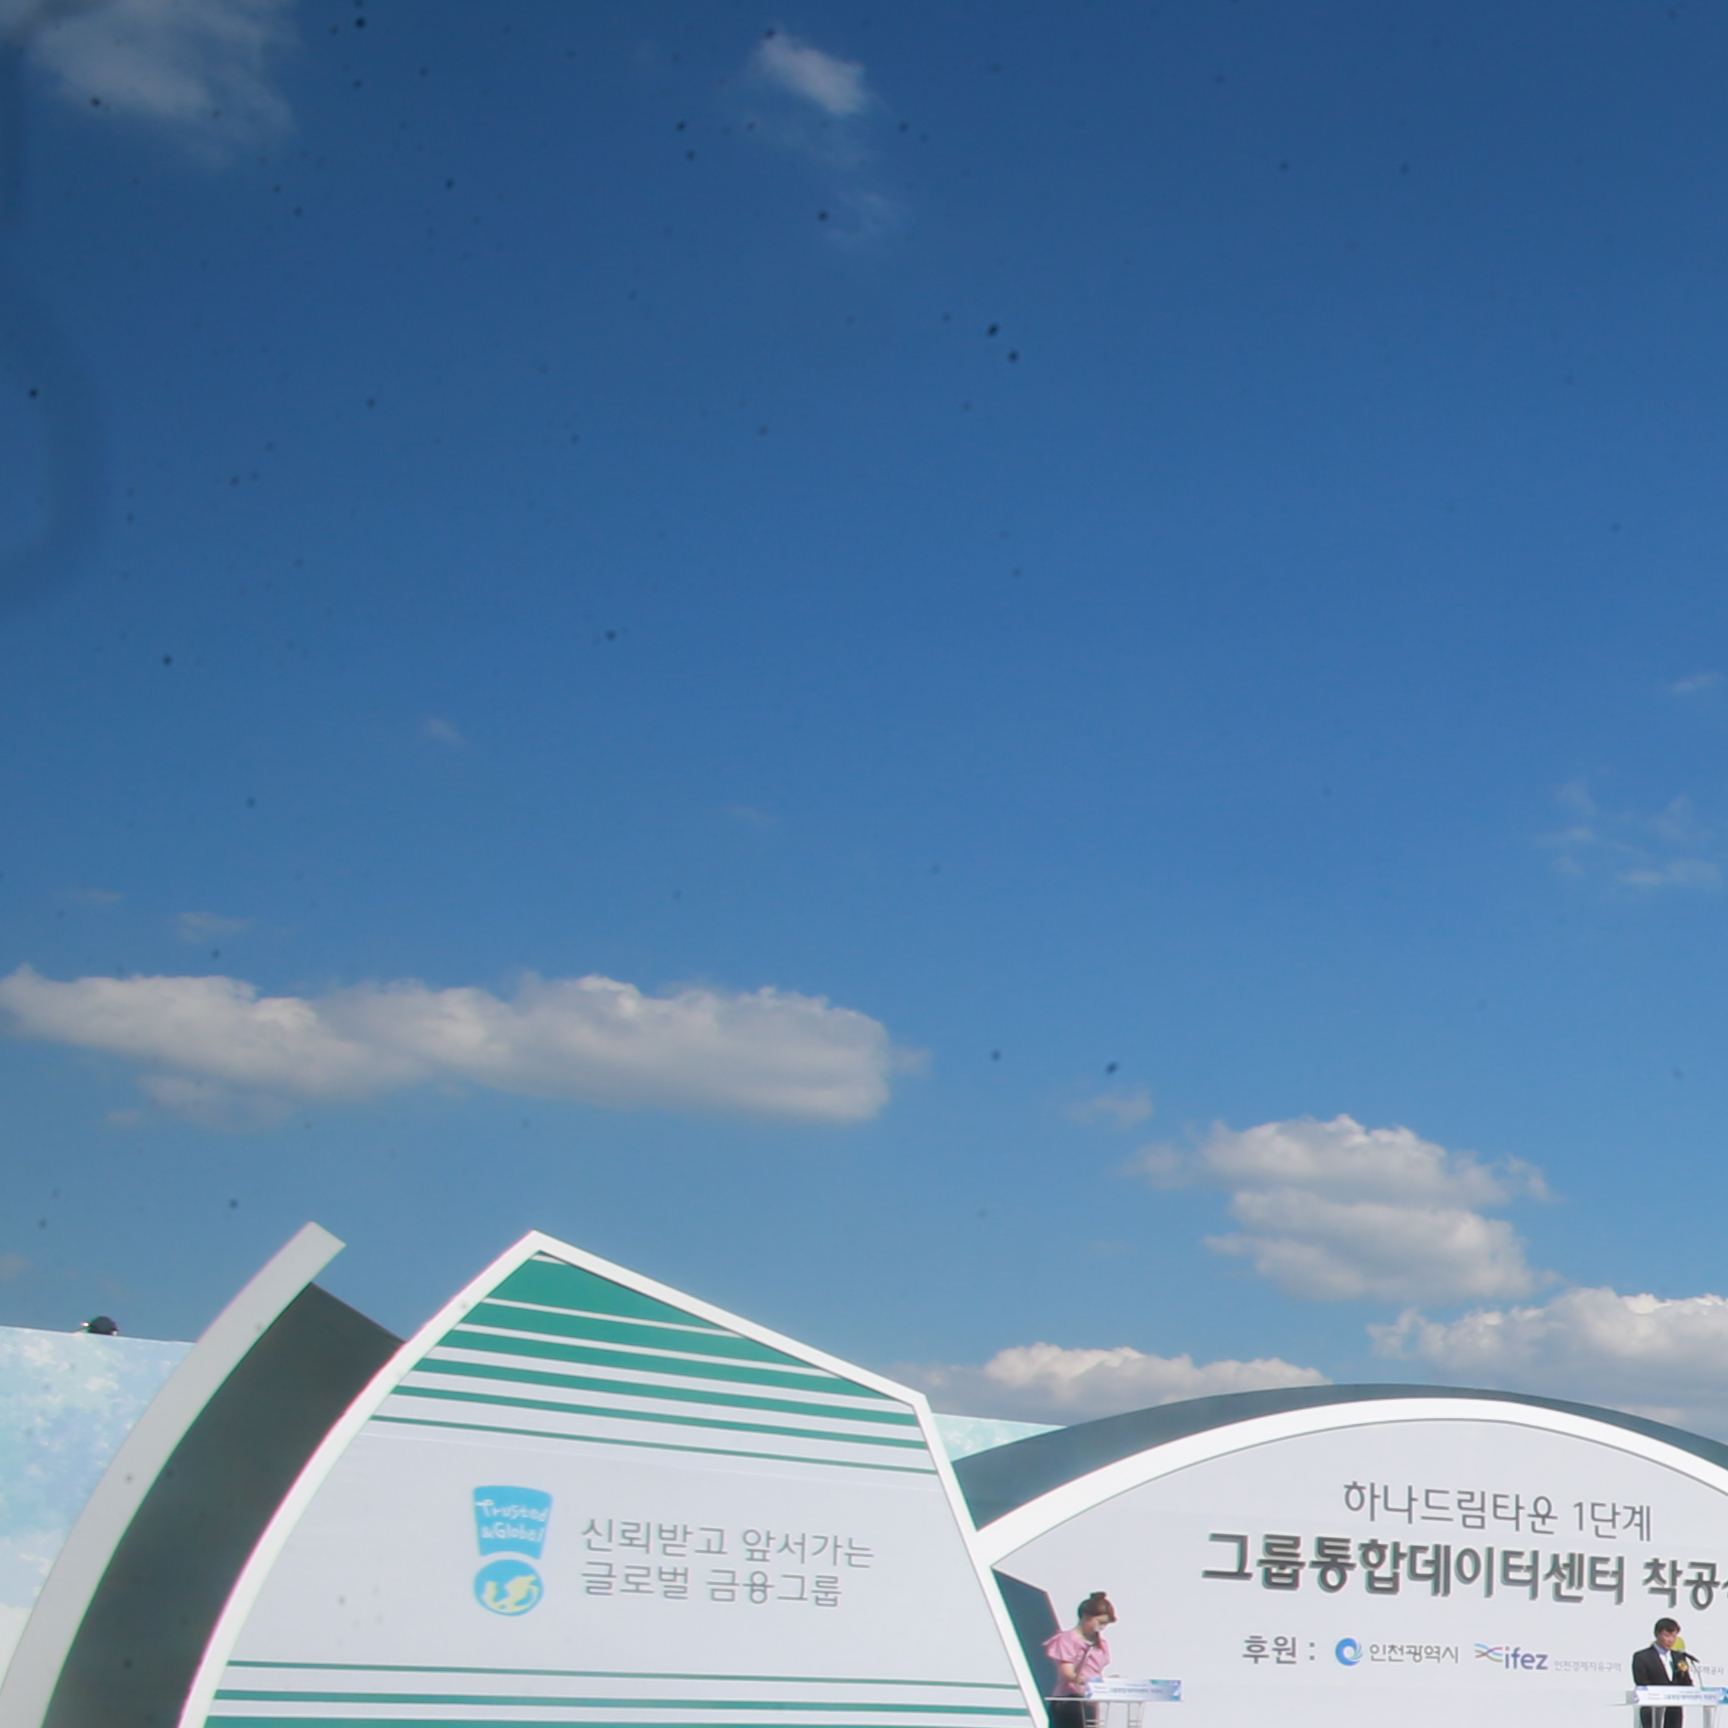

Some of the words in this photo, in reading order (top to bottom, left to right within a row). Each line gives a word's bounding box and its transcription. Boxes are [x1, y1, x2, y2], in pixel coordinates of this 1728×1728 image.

[476, 1499, 547, 1523] Trusted
[1343, 1480, 1558, 1536] 하나드림타운
[1573, 1500, 1651, 1542] 1단계
[481, 1523, 544, 1544] &Global
[581, 1517, 728, 1557] 신뢰받고
[742, 1527, 875, 1569] 앞서가는
[1201, 1531, 1625, 1605] 그룹통합데이터센터
[581, 1560, 690, 1600] 글로벌
[706, 1567, 842, 1608] 금융그룹
[1242, 1635, 1298, 1665] 후원
[1369, 1643, 1460, 1664] 인천광역시
[1504, 1646, 1549, 1671] ifez
